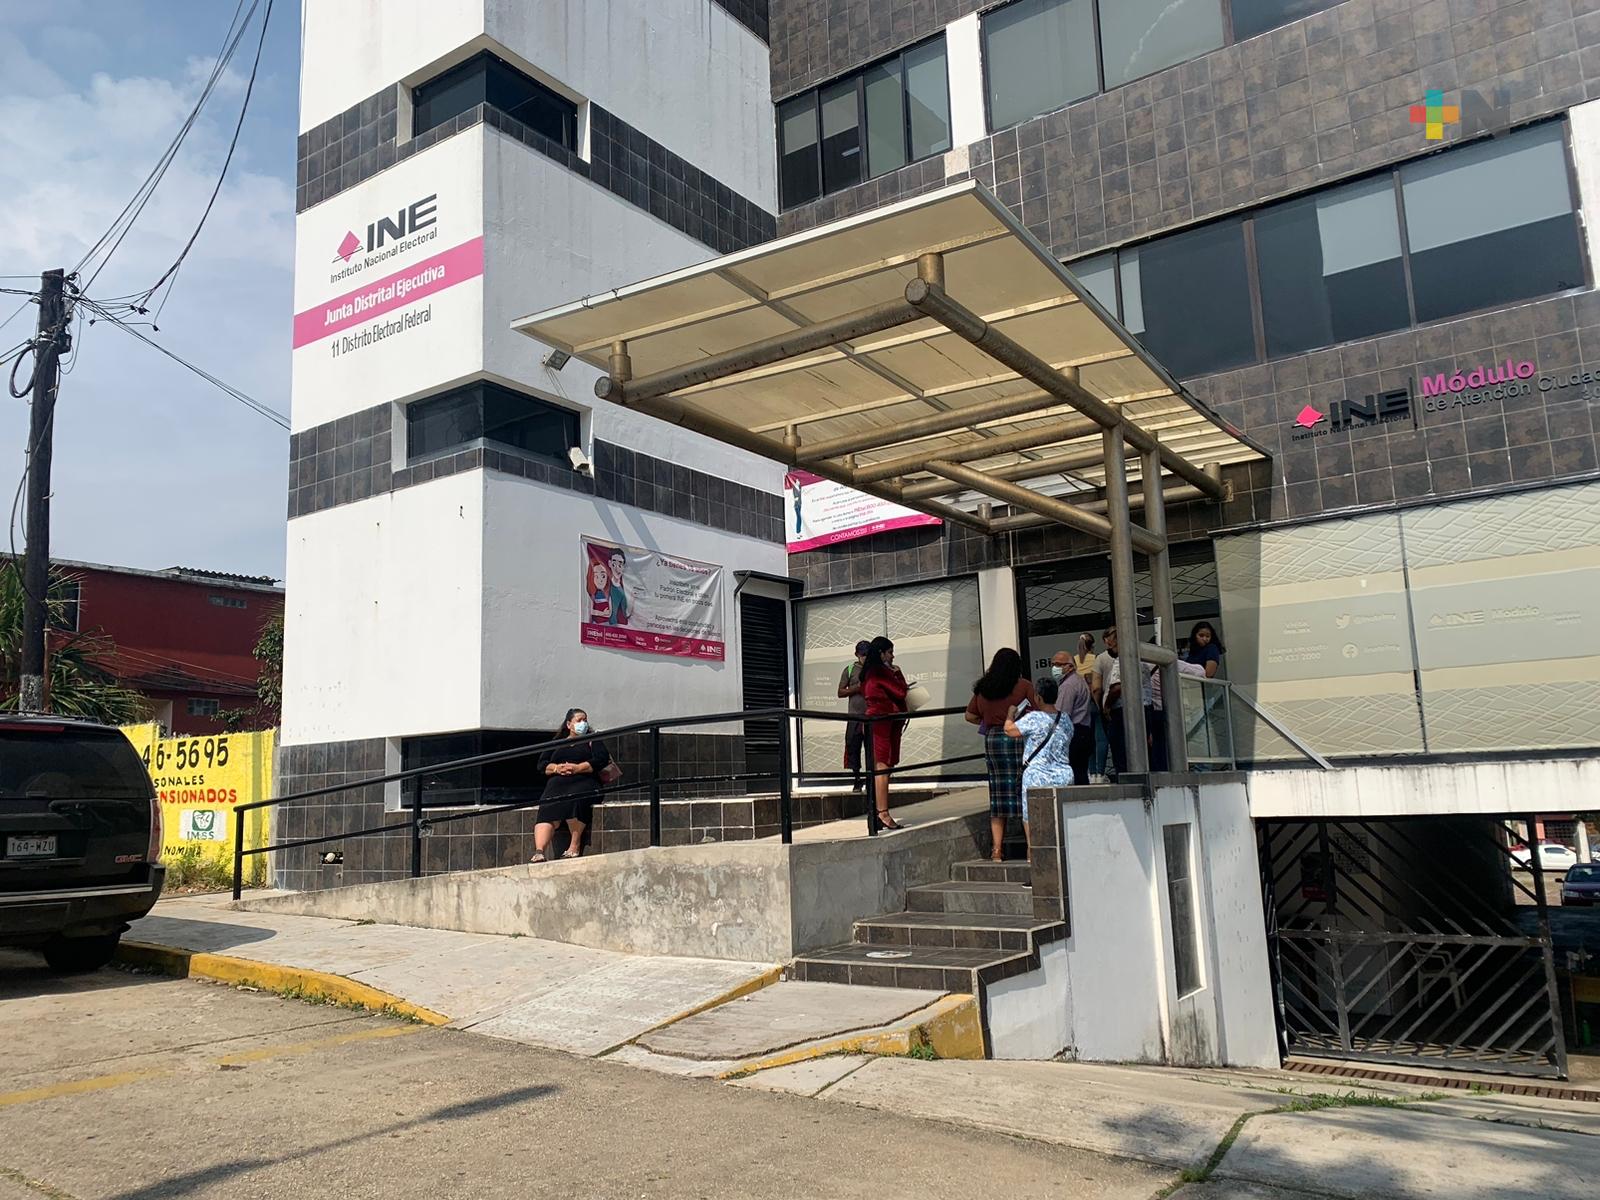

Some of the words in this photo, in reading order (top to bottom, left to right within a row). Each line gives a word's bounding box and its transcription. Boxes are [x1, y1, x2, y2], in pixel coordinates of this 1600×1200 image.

[367, 193, 437, 253] INE
[330, 264, 363, 284] Instituto
[364, 245, 399, 268] Nacional
[399, 227, 438, 254] Electoral
[324, 304, 353, 326] Junta
[354, 283, 395, 314] Distrital
[396, 264, 445, 298] Ejecutiva
[331, 339, 341, 358] 11
[342, 330, 373, 355] Distrito
[373, 314, 404, 343] Electoral
[404, 303, 432, 331] Federal
[1422, 359, 1536, 398] Módulo
[1329, 388, 1410, 425] INE
[1425, 398, 1448, 412] de
[1451, 382, 1531, 408] Atención
[1291, 429, 1328, 441] Instituto
[1329, 421, 1368, 435] Nacional
[1371, 413, 1411, 425] Electoral
[1446, 609, 1484, 625] INE
[707, 645, 722, 653] INE
[187, 831, 215, 841] IMSS
[115, 854, 143, 864] GMC
